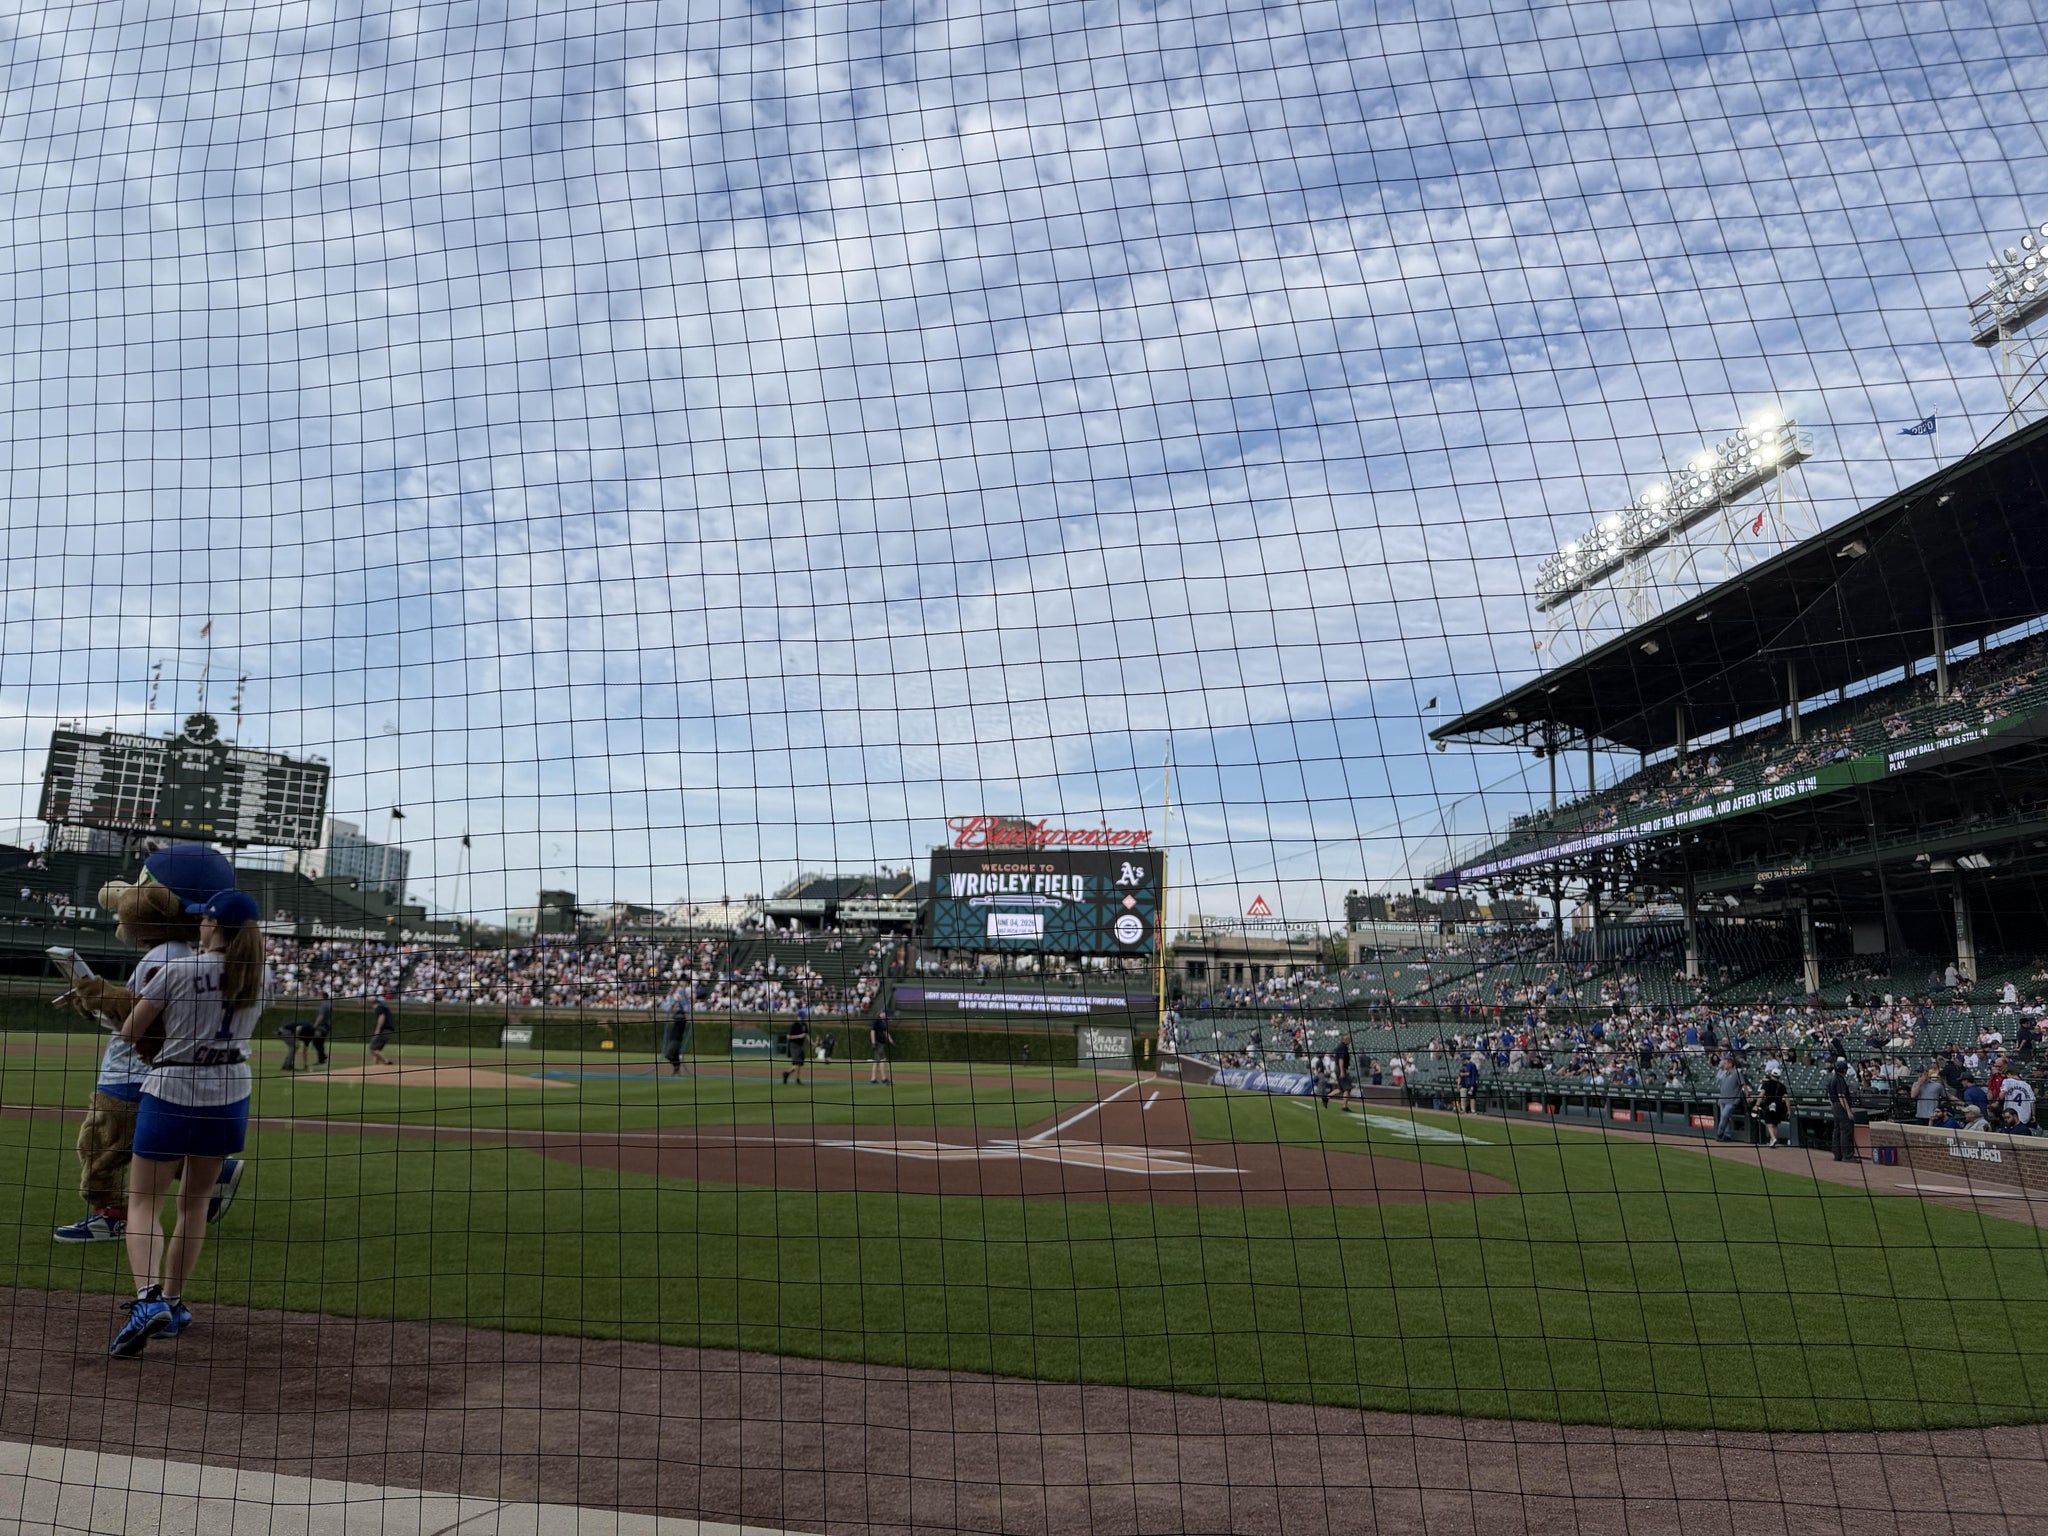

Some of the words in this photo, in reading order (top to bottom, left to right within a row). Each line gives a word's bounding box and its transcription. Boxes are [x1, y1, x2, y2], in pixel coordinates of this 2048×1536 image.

[110, 734, 168, 751] NATIONAL
[1888, 751, 1905, 762] WITH
[1905, 747, 1918, 757] ANY
[1919, 743, 1936, 754] BALL
[1936, 738, 1953, 750] THAT
[1953, 735, 1961, 745] IS
[1961, 731, 1980, 743] STILL
[1980, 727, 1989, 737] IN
[225, 749, 283, 766] AMERICAN
[1889, 760, 1908, 772] PLAY.
[947, 816, 1153, 848] Budweiser
[1472, 864, 1486, 877] SHOWS
[1486, 861, 1498, 874] TAKE
[1498, 859, 1512, 872] PLACE
[1511, 849, 1548, 868] APPROXIMATELY
[1548, 845, 1560, 859] FIVE
[1560, 839, 1582, 855] MINUTES
[1582, 834, 1604, 849] BEFORE
[1603, 829, 1619, 845] FIRST
[1619, 826, 1640, 840] PITCH,
[1640, 821, 1653, 835] END
[1653, 818, 1662, 831] OF
[1661, 815, 1675, 829] THE
[1675, 810, 1689, 825] 8TH
[1689, 804, 1715, 821] INNING,
[1716, 801, 1731, 816] AND
[1732, 792, 1757, 812] AFTER
[1757, 788, 1773, 805] THE
[1773, 782, 1796, 800] CUBS
[1797, 775, 1818, 794] WIN!
[981, 863, 1036, 872] WELCOME
[1039, 863, 1055, 873] TO
[950, 872, 1030, 900] WRIGLEY
[1035, 873, 1085, 903] FIELD
[51, 904, 97, 919] YETI
[311, 922, 387, 940] Budweiser
[1202, 916, 1268, 933] Benjamin
[1272, 919, 1318, 932] Moore
[413, 931, 461, 943] Advocate
[732, 1038, 773, 1048] SLOAN
[1086, 1034, 1127, 1045] DRAFT
[1090, 1043, 1126, 1053] KINGS
[2013, 1092, 2023, 1107] 4
[1946, 1137, 2002, 1163] TimberTech
